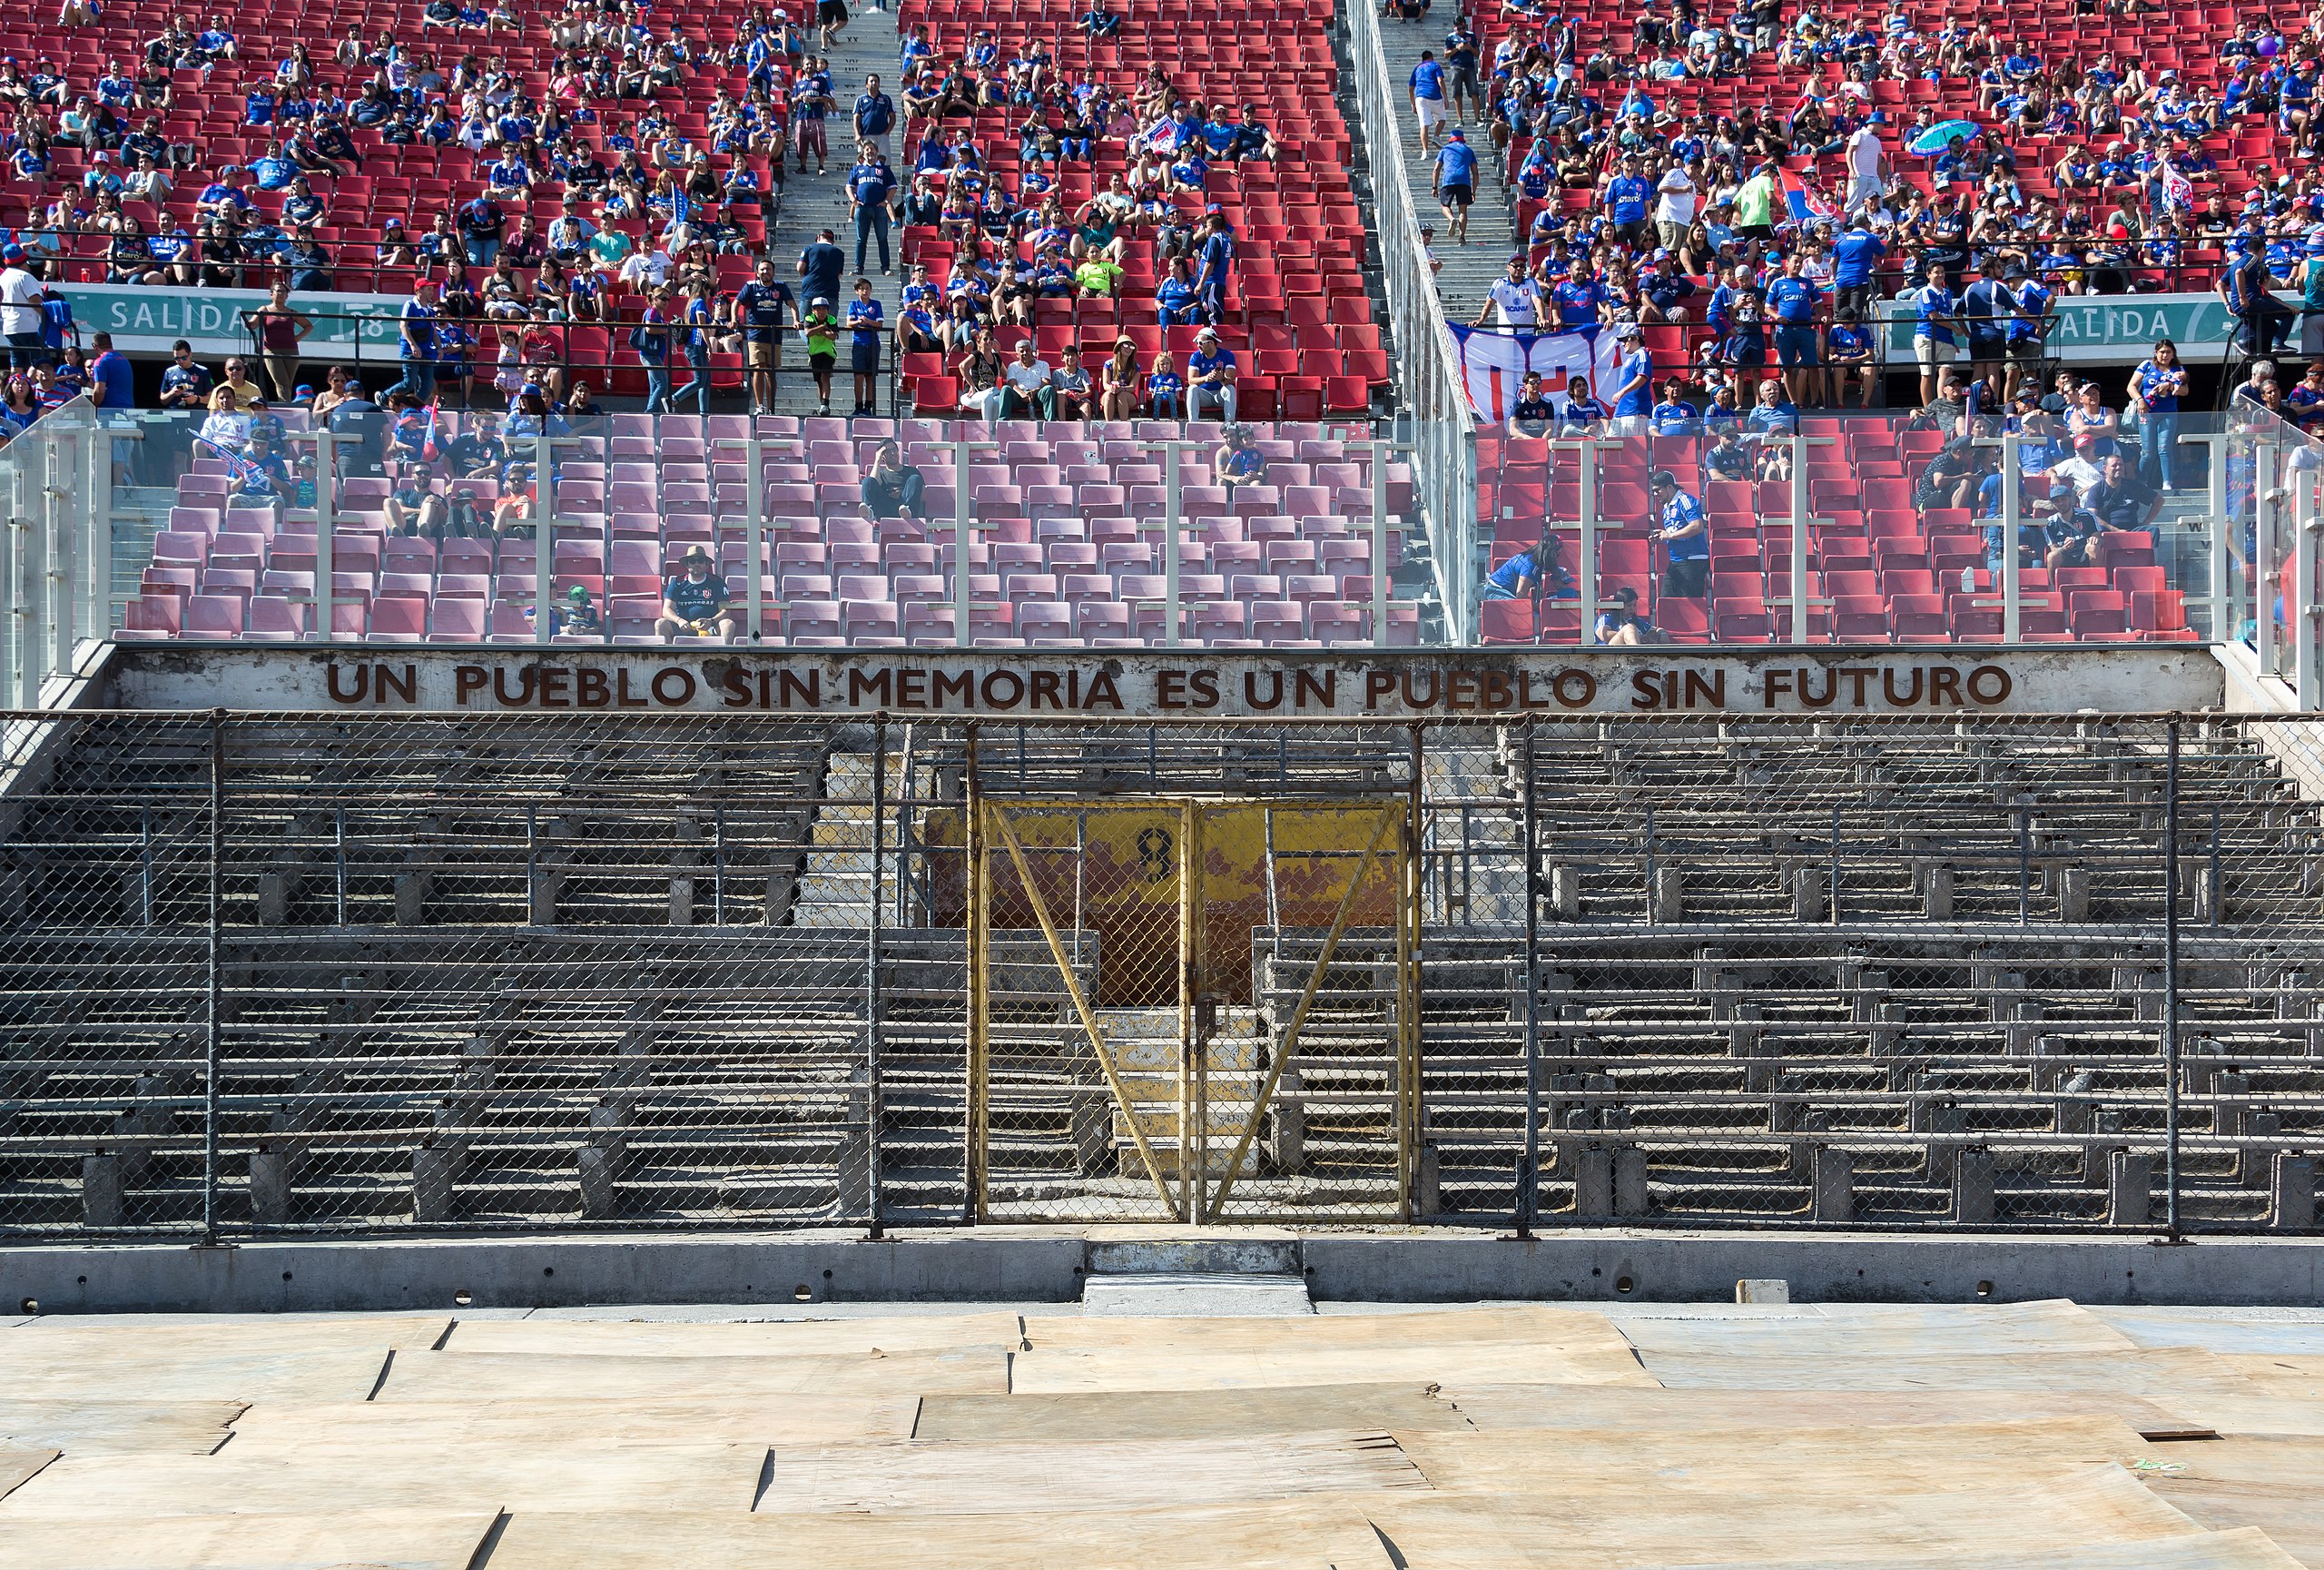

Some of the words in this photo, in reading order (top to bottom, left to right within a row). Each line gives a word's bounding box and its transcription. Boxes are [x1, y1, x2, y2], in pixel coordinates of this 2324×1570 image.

[116, 251, 143, 260] Claro
[110, 301, 248, 332] SALIDA
[2048, 310, 2171, 338] ALIDA
[327, 664, 417, 704] UN
[456, 666, 697, 706] PUEBLO
[724, 667, 819, 708] SIN
[849, 667, 1125, 709] MEMORIA
[1157, 668, 1220, 708] ES
[1244, 669, 1335, 709] UN
[1366, 668, 1598, 708] PUEBLO
[1631, 669, 1725, 708] SIN
[1764, 665, 2013, 707] FUTURO
